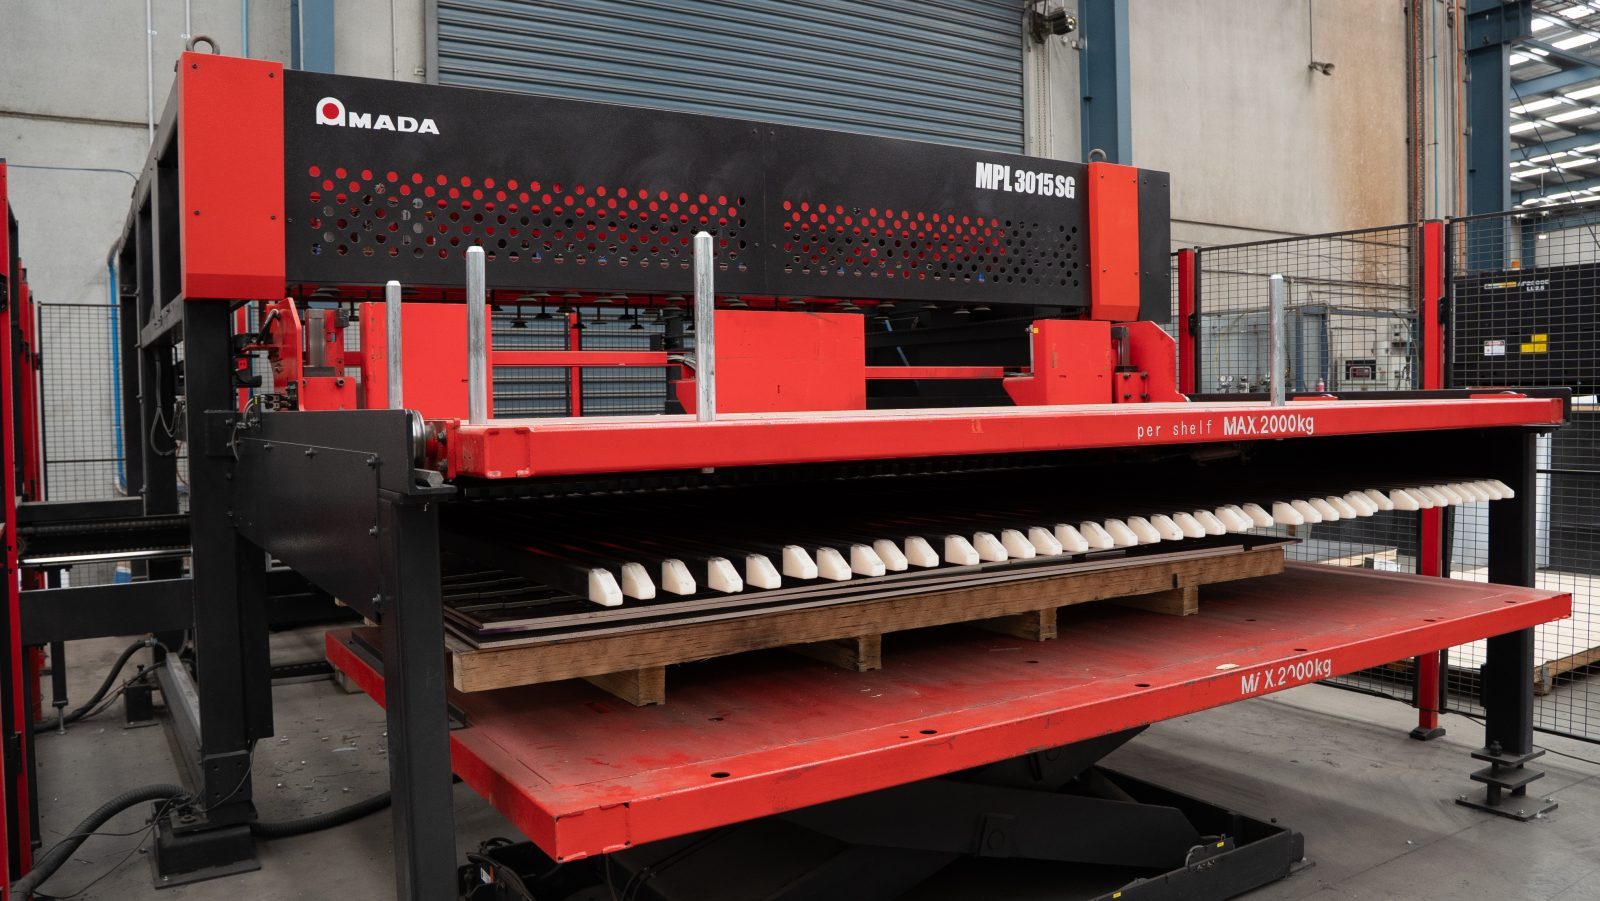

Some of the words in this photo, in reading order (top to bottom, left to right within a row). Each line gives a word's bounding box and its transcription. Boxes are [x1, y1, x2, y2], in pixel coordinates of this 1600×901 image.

[316, 97, 440, 135] AMADA
[975, 161, 1012, 192] MPL
[1137, 424, 1161, 440] per
[1172, 419, 1213, 437] shelf
